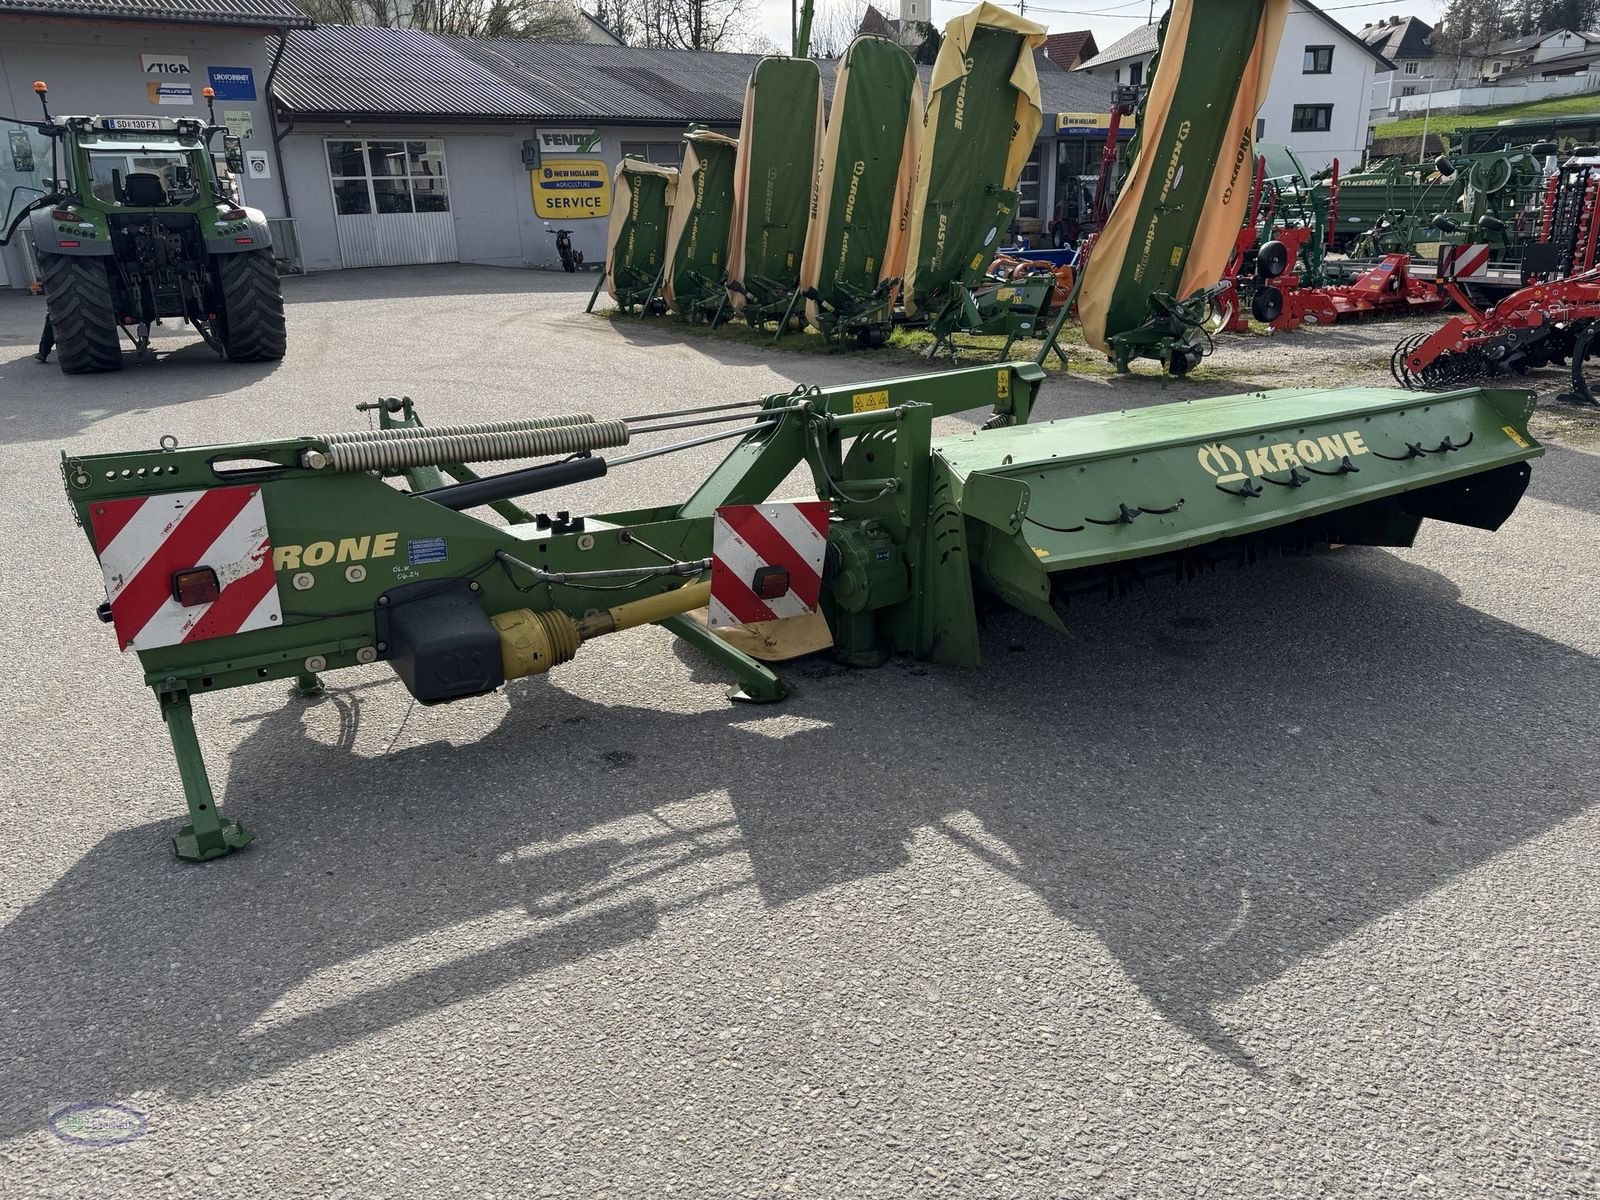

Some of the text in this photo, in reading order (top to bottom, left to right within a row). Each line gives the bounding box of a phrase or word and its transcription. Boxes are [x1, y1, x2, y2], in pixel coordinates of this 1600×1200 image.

[147, 63, 190, 73] STIGA
[955, 76, 968, 130] KRONE
[116, 120, 127, 128] SD
[541, 133, 592, 146] FENDT
[1159, 140, 1183, 204] KRONE
[1231, 126, 1251, 191] KRONE
[546, 197, 602, 209] SERVICE
[696, 169, 707, 210] KRONE
[845, 175, 860, 223] KRONE
[1245, 430, 1370, 477] KRONE
[272, 532, 399, 571] RONE
